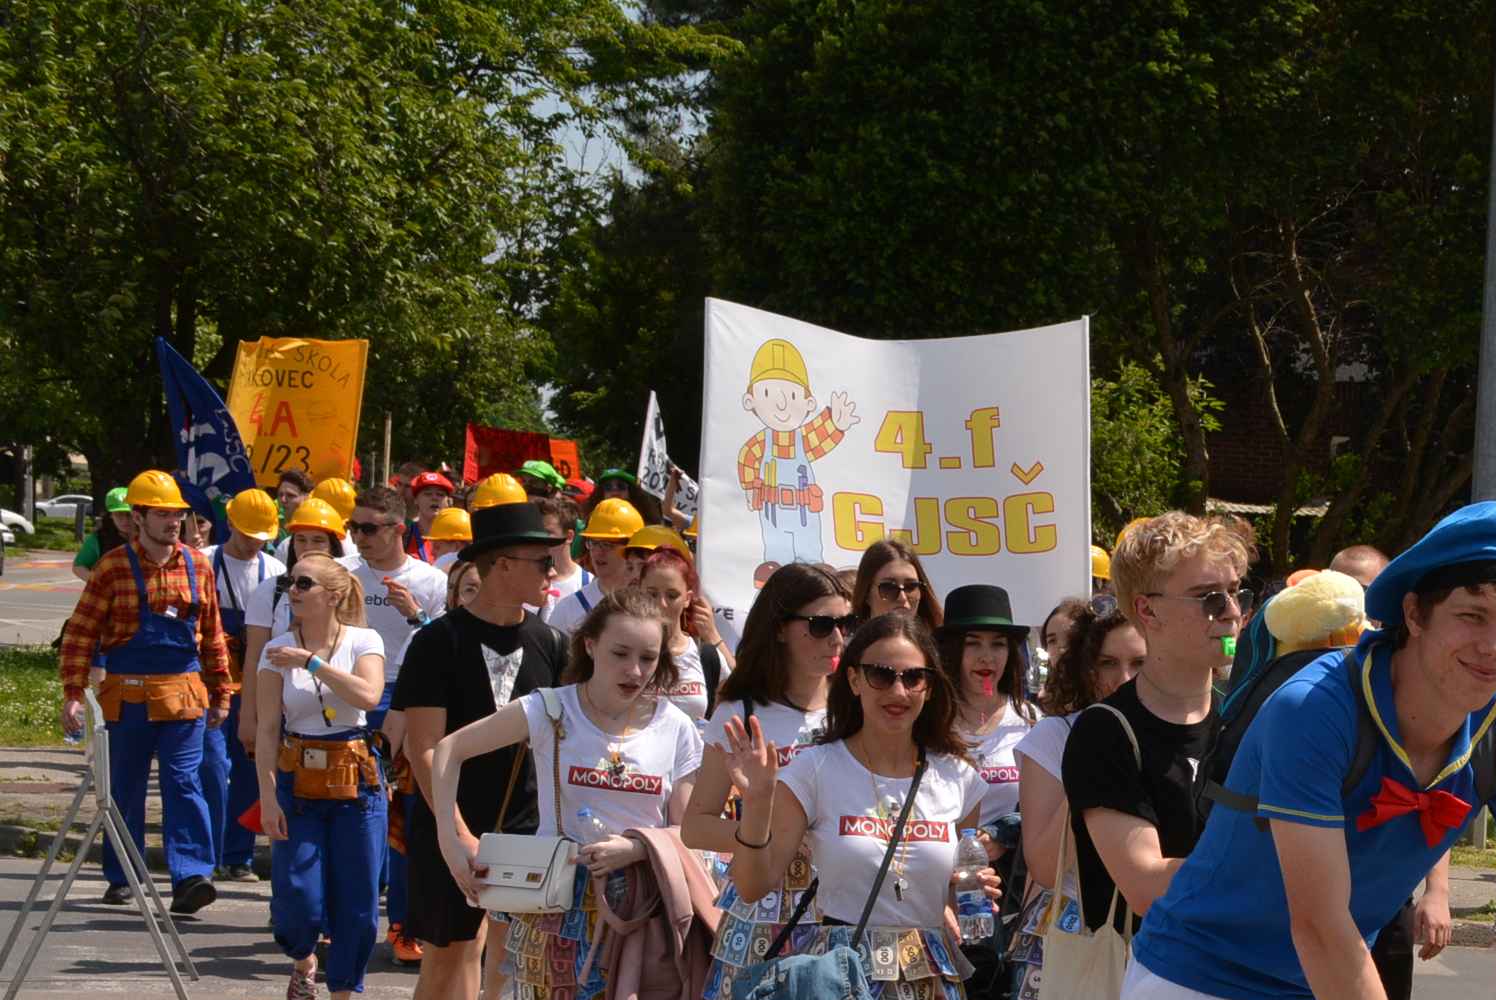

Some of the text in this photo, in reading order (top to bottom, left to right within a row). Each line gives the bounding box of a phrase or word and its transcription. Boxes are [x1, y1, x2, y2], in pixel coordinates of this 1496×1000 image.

[832, 461, 1057, 556] GJSČ
[572, 769, 662, 792] MONOPOLY
[758, 939, 766, 953] 100
[879, 947, 889, 963] 100
